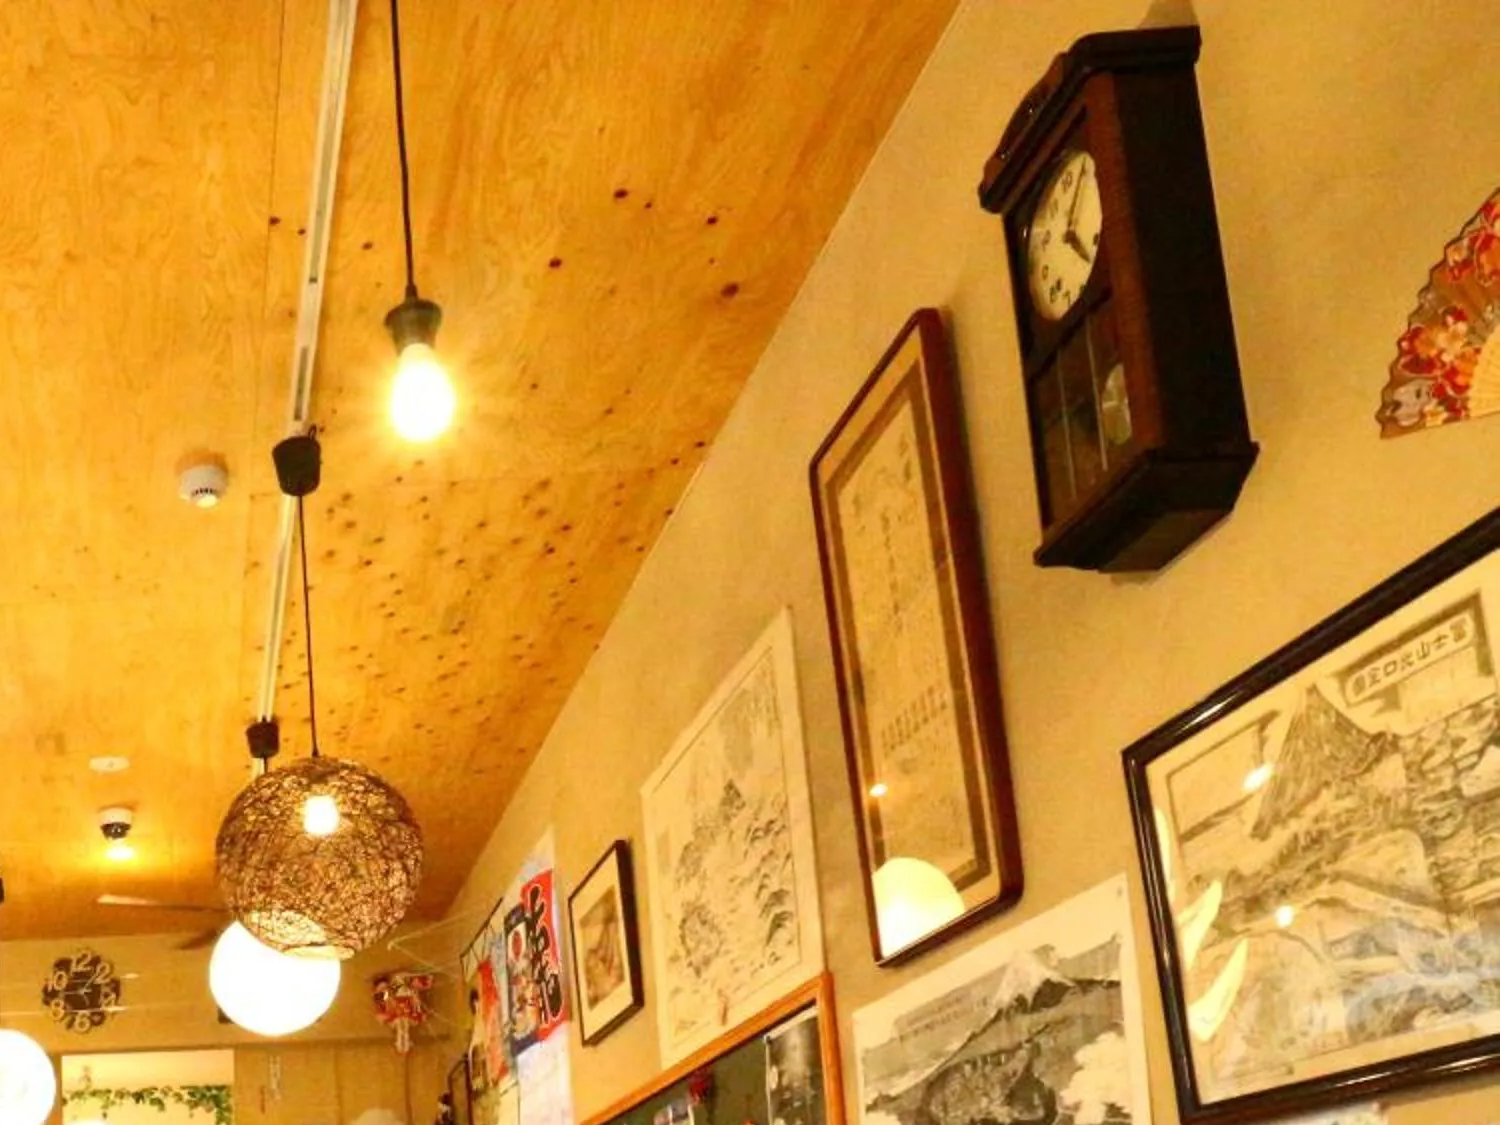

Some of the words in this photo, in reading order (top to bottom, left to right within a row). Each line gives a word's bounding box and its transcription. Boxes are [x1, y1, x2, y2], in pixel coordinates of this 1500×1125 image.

[71, 950, 92, 972] 12
[44, 970, 68, 992] 10
[93, 962, 111, 984] 2
[50, 998, 64, 1021] 8
[75, 1011, 91, 1032] 6
